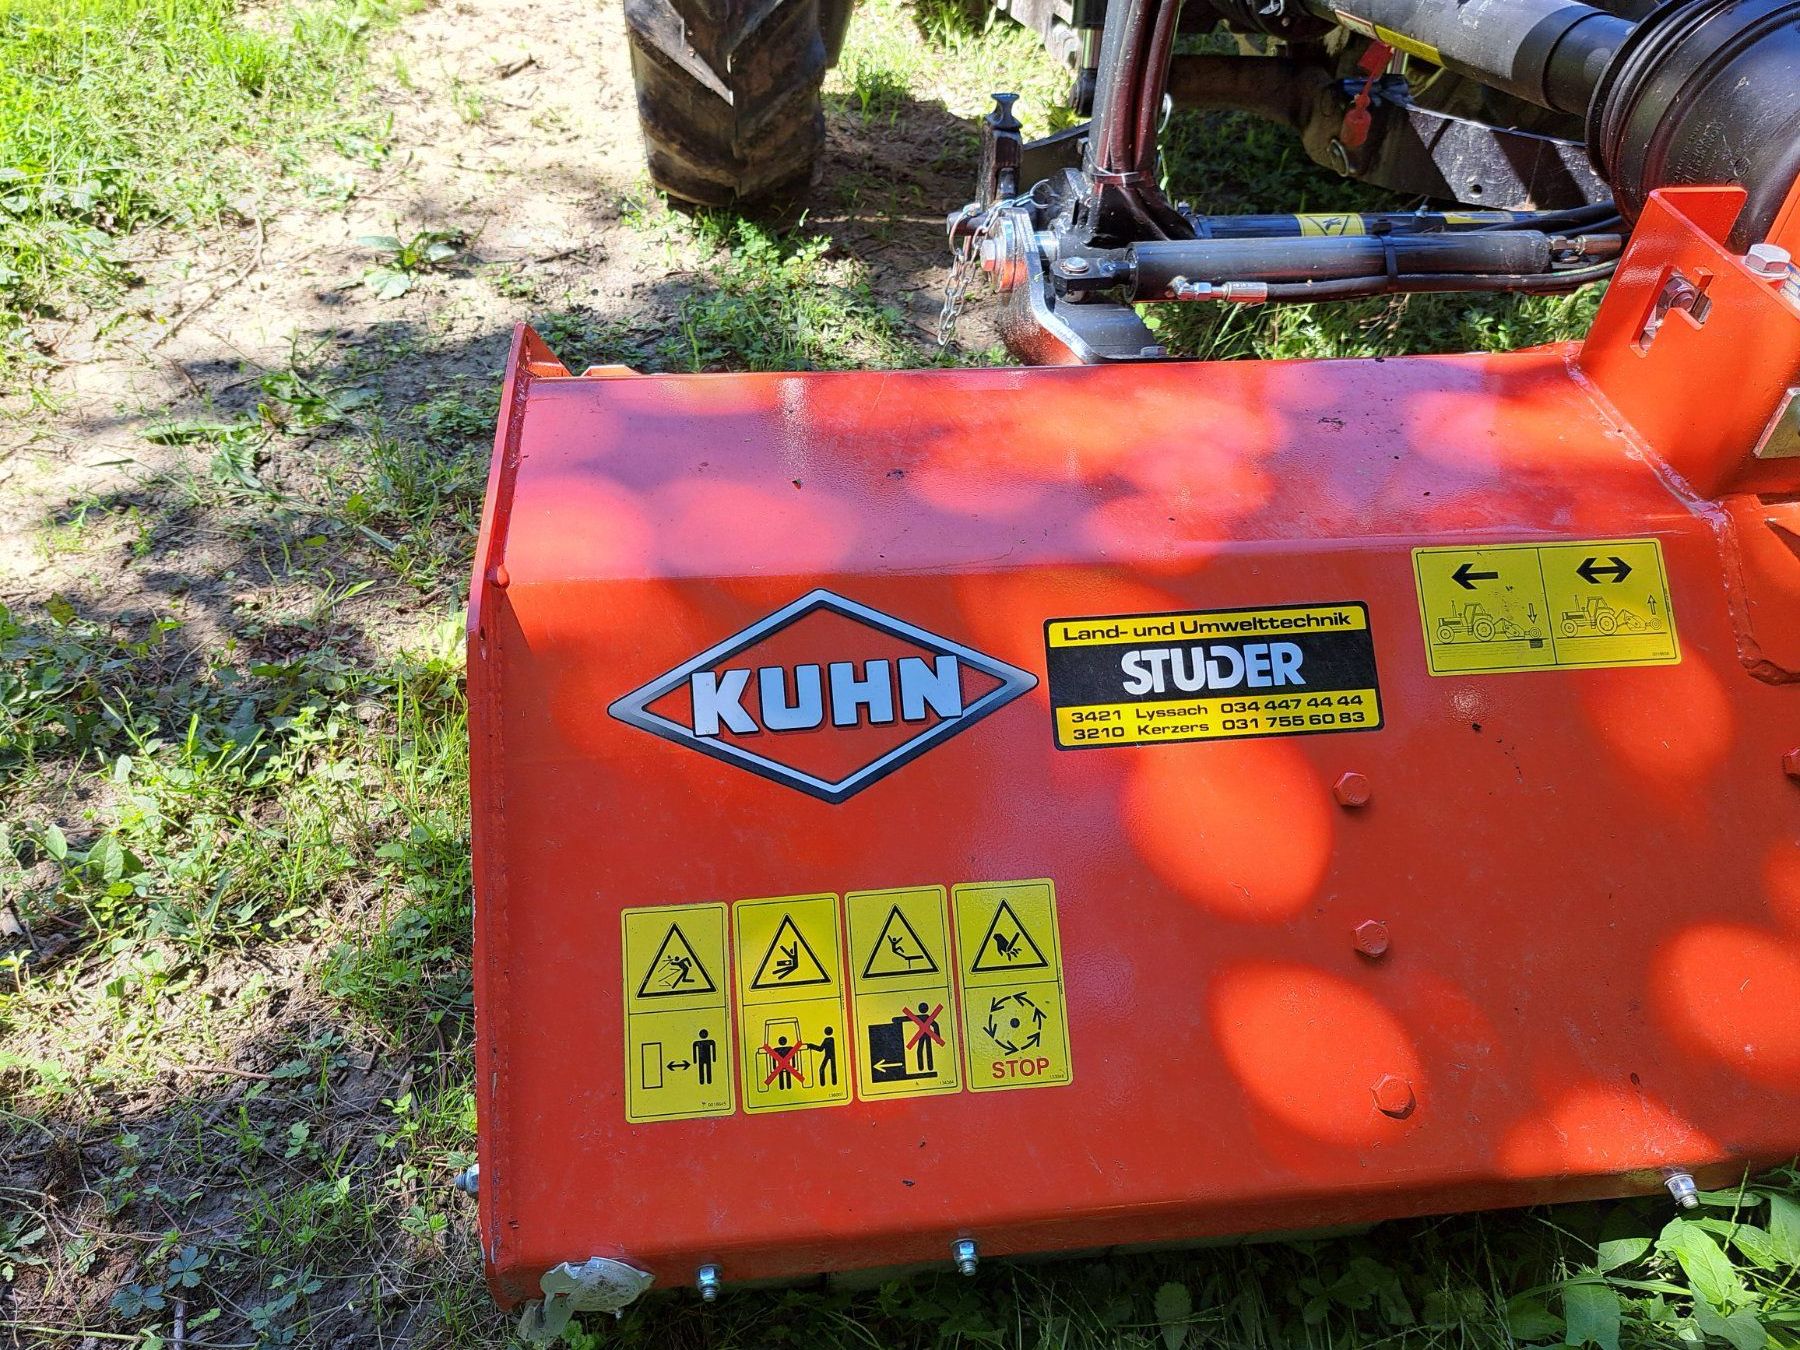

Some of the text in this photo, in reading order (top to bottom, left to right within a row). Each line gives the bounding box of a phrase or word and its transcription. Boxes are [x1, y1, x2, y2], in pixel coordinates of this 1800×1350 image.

[1063, 612, 1352, 642] Land- und Umwelttechnik
[1120, 642, 1307, 696] STUDER
[690, 655, 964, 737] KUHN
[1071, 695, 1364, 724] 3421 Lyssach 034 447 44 44
[1073, 711, 1366, 740] 3210 Kerzers 031 755 60 83
[991, 1057, 1051, 1080] STOP
